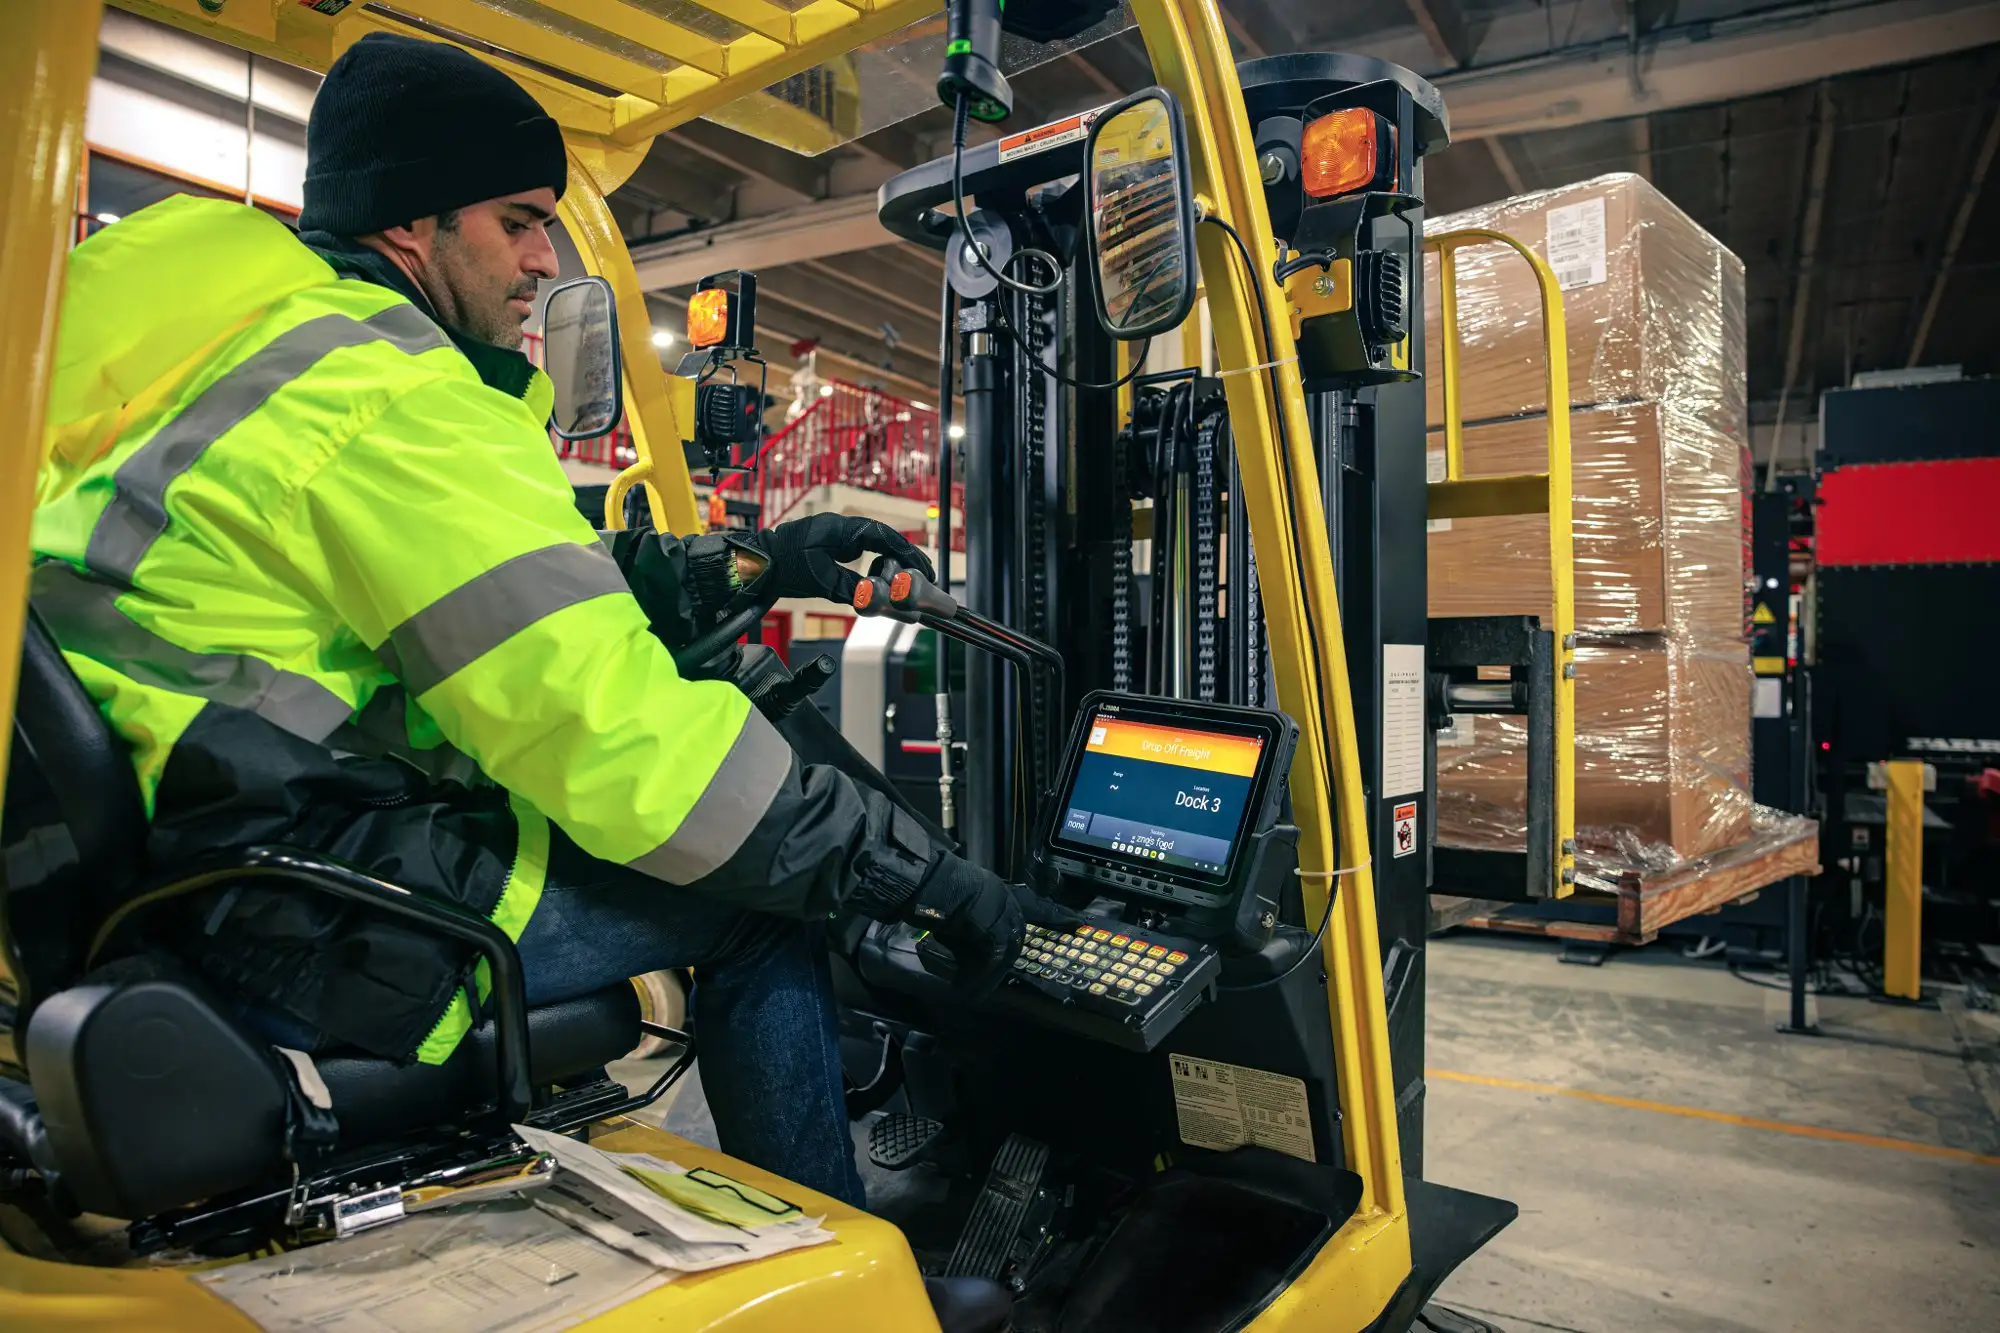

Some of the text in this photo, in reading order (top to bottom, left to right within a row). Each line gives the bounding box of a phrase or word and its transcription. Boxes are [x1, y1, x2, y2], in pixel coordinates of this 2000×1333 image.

[1024, 143, 1037, 152] MAST
[1039, 138, 1056, 147] CRUSH
[1142, 740, 1211, 760] Drop Off Freight
[1175, 791, 1222, 813] Dock 3
[1067, 820, 1085, 831] none
